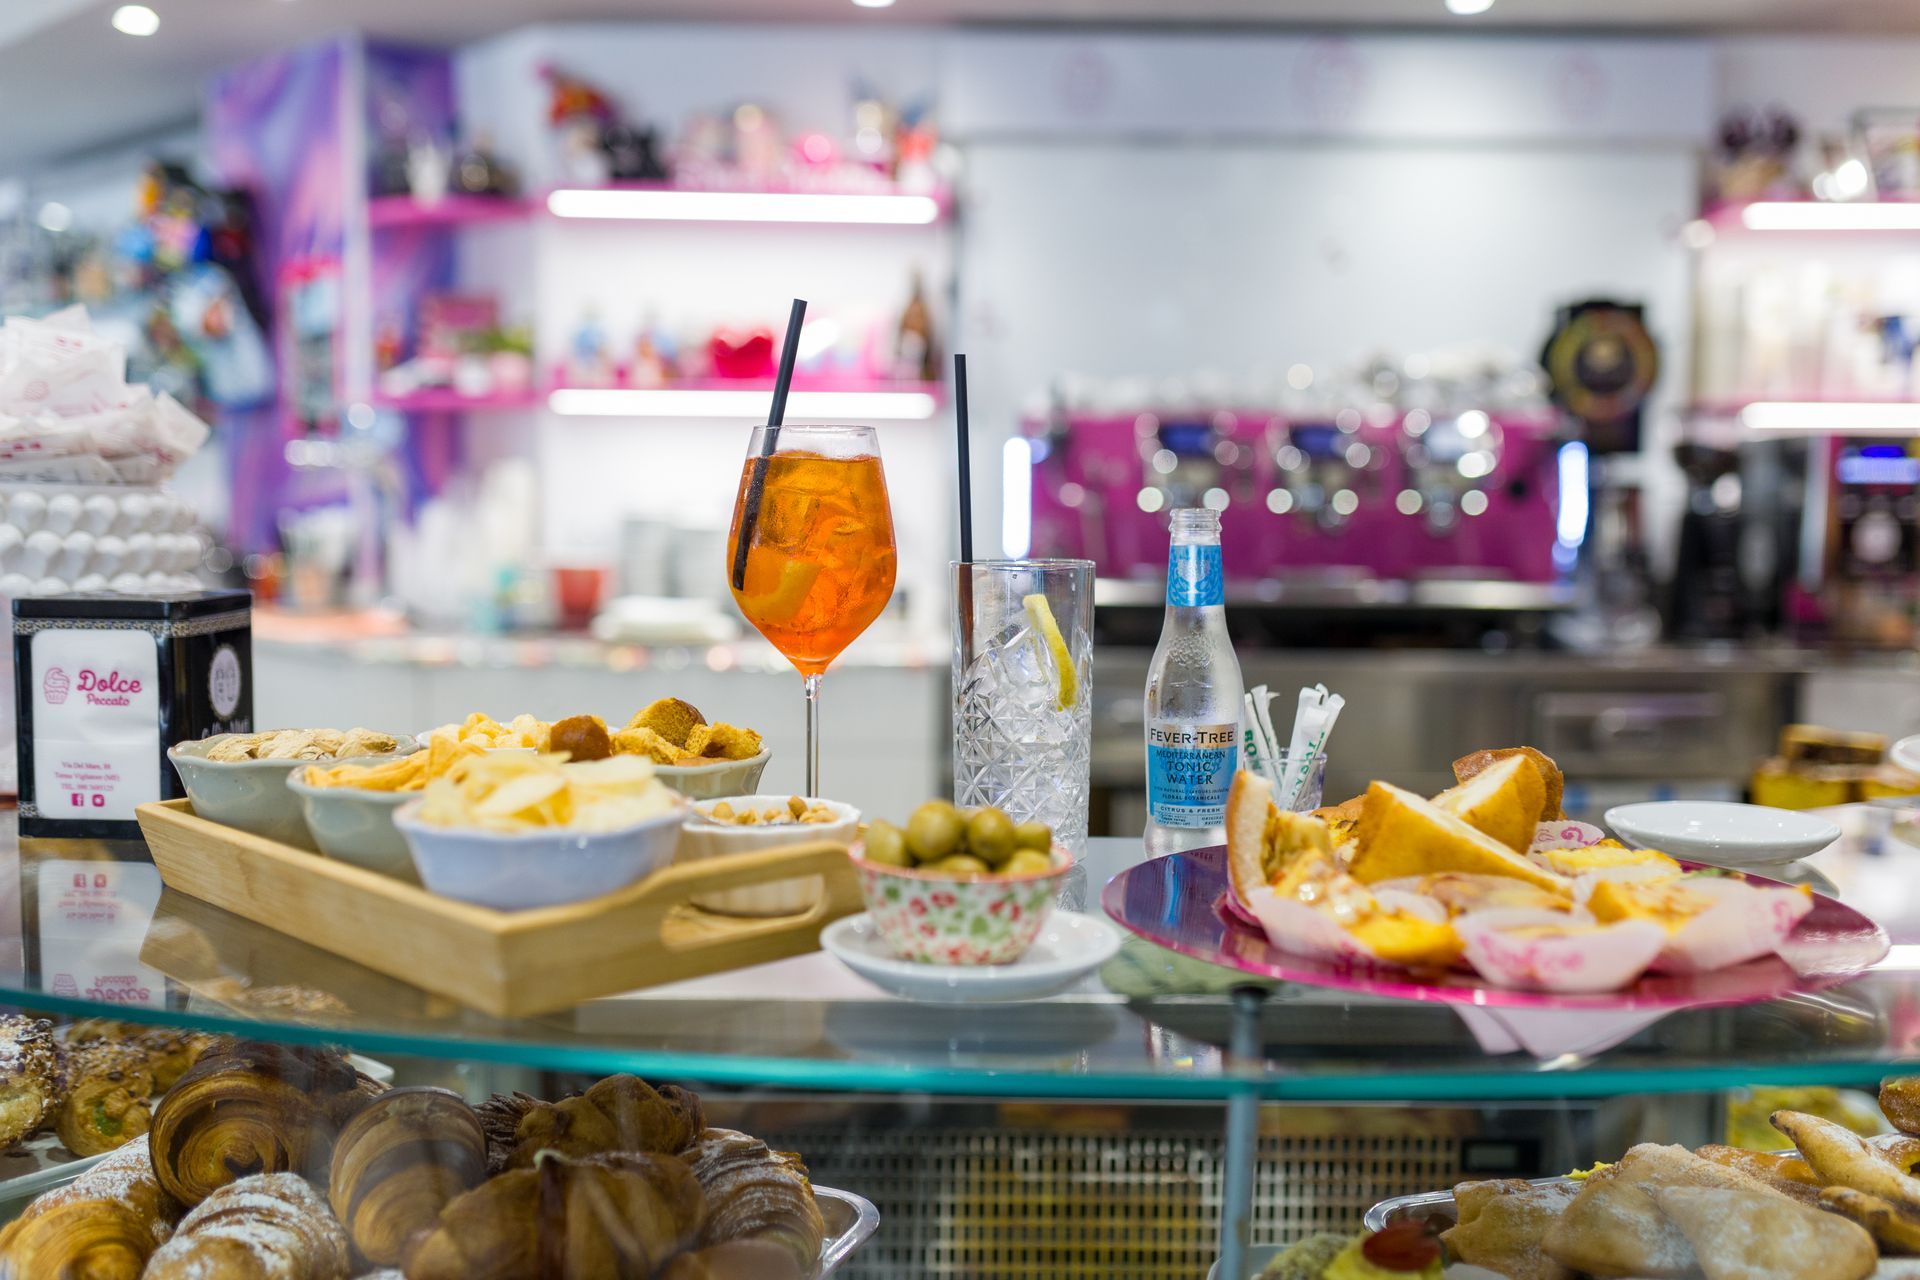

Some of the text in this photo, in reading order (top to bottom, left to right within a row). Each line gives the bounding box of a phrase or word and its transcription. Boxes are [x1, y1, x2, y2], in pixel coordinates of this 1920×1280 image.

[77, 669, 142, 693] Dolce
[86, 693, 130, 706] Peccato
[1150, 728, 1234, 743] FEVER-TREE
[1156, 750, 1226, 760] MEDITERRANEAN
[1167, 761, 1211, 772] TONIC
[1166, 774, 1213, 785] WATER
